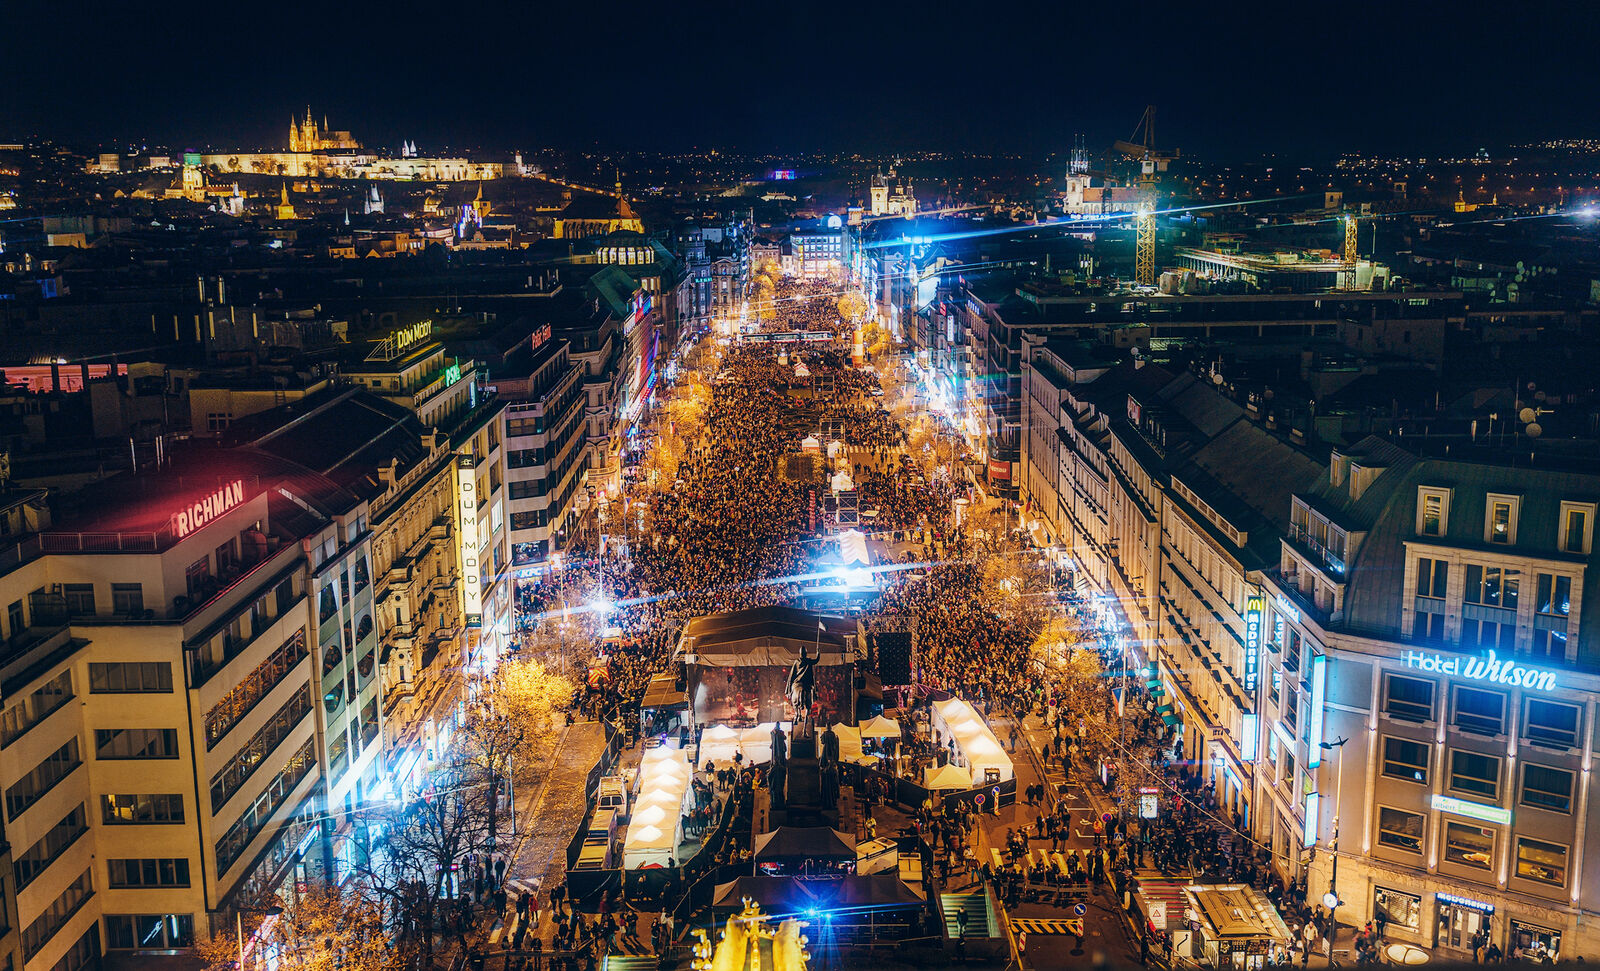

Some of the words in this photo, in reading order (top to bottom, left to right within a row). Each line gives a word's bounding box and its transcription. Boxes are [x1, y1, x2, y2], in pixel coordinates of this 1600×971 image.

[177, 480, 243, 538] RICHMAN
[1408, 650, 1459, 676] Hotel
[1463, 649, 1557, 692] Wilson
